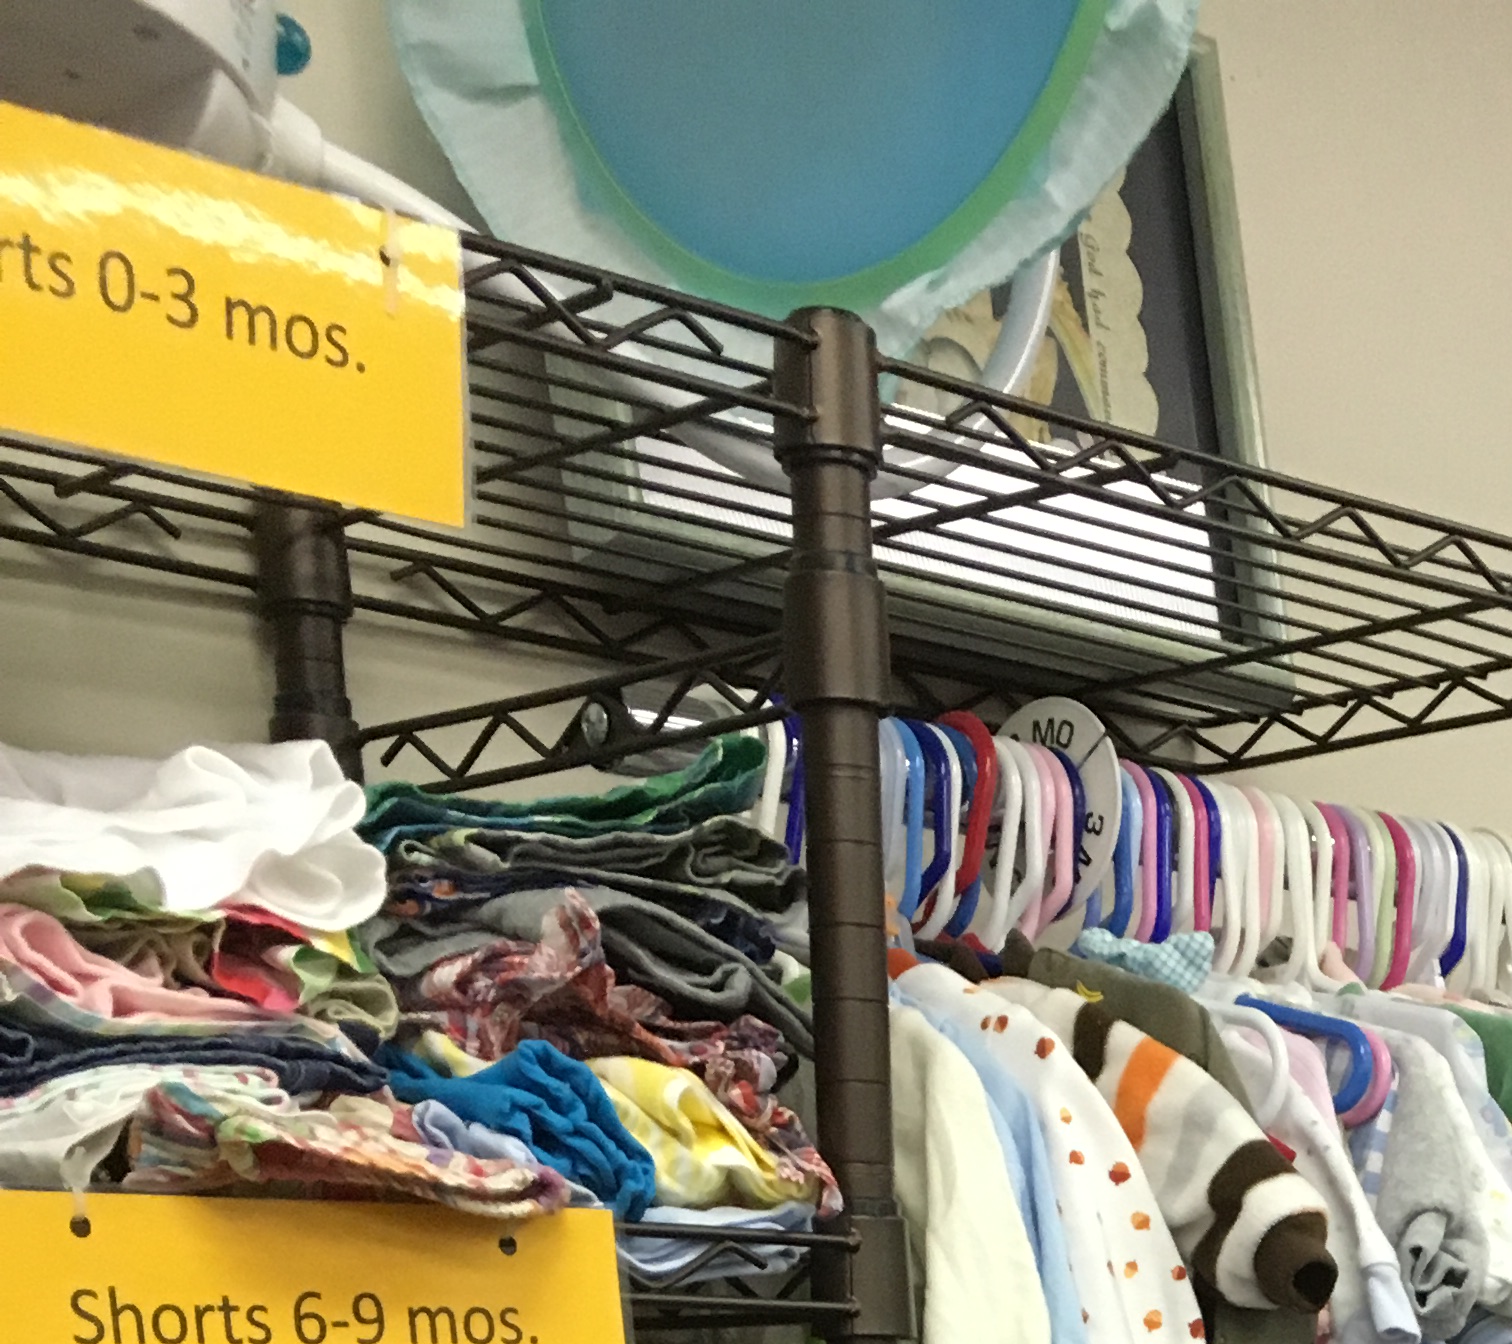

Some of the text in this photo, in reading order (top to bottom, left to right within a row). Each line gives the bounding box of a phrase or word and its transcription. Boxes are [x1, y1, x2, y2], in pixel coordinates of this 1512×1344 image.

[98, 250, 200, 331] 0-3
[223, 295, 368, 375] mos.
[1032, 717, 1075, 749] MO
